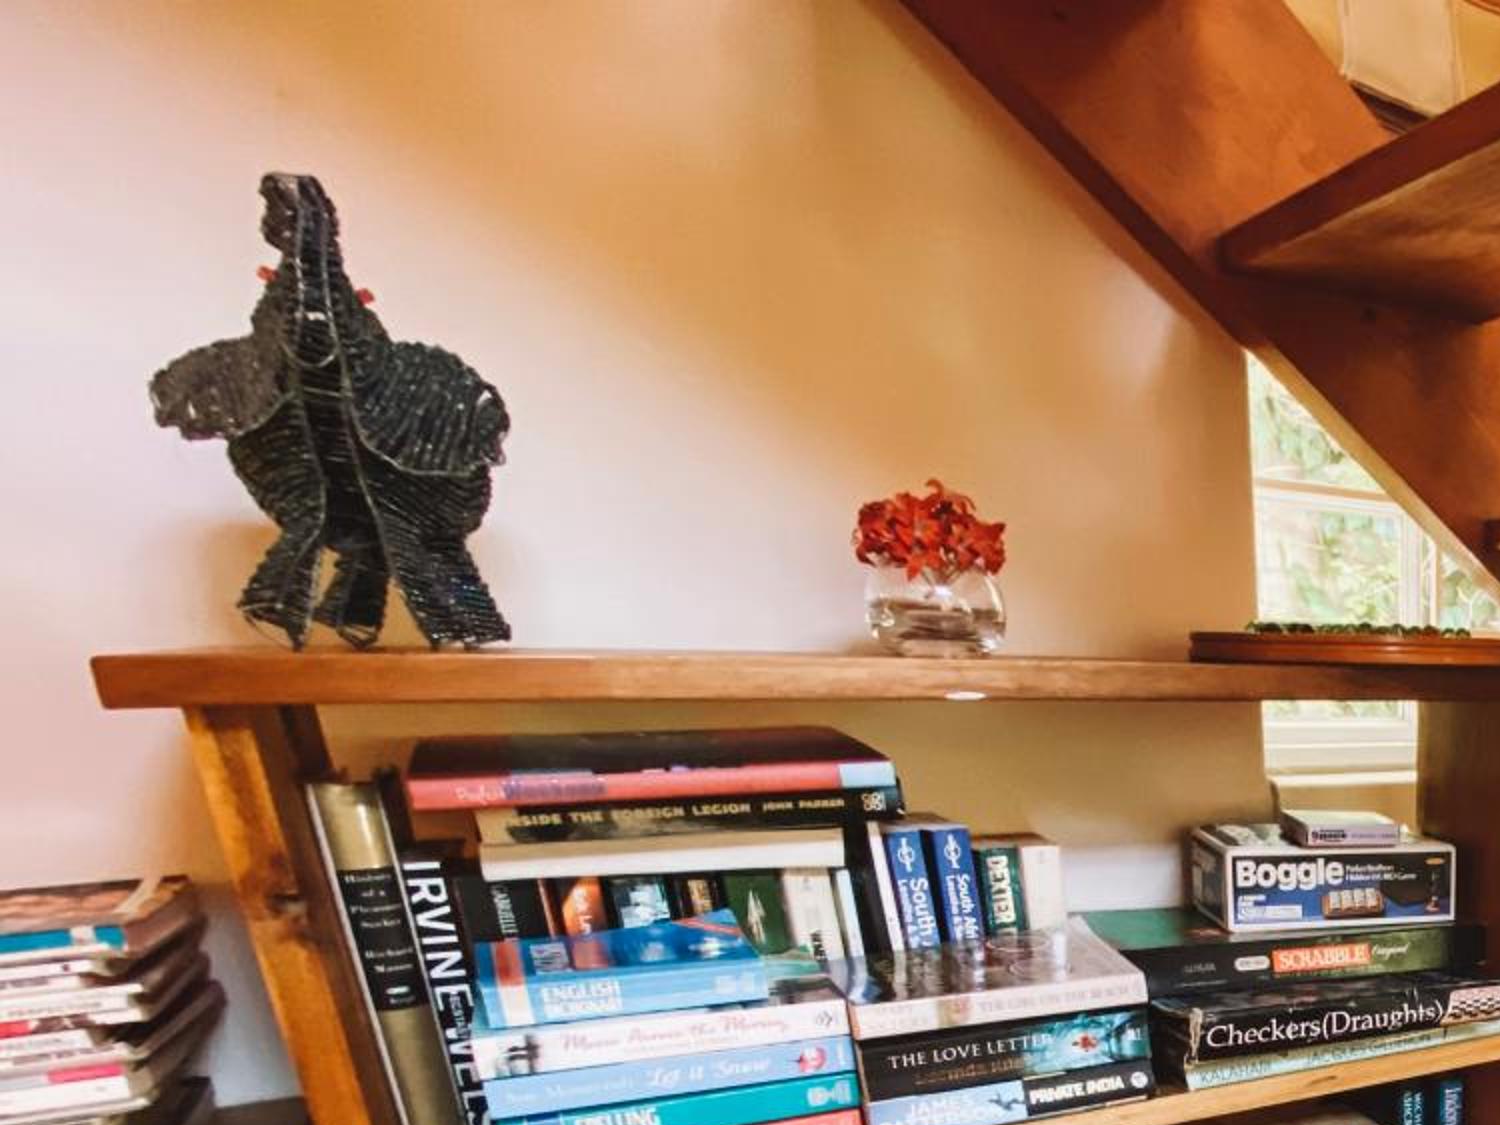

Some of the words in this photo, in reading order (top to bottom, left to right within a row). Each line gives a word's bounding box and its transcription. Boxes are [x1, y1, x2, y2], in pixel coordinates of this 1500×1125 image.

[692, 802, 751, 817] LEGION
[985, 855, 1016, 924] DEXTER
[1235, 858, 1345, 891] Boggle
[909, 876, 938, 939] South
[957, 872, 975, 913] South
[402, 861, 475, 1011] IRVINE
[1280, 945, 1370, 972] SCRABBLE
[888, 1052, 926, 1070] THE
[933, 1042, 982, 1063] LOVE
[1029, 1081, 1084, 1105] PRIVATE
[1086, 1075, 1125, 1094] INDIA
